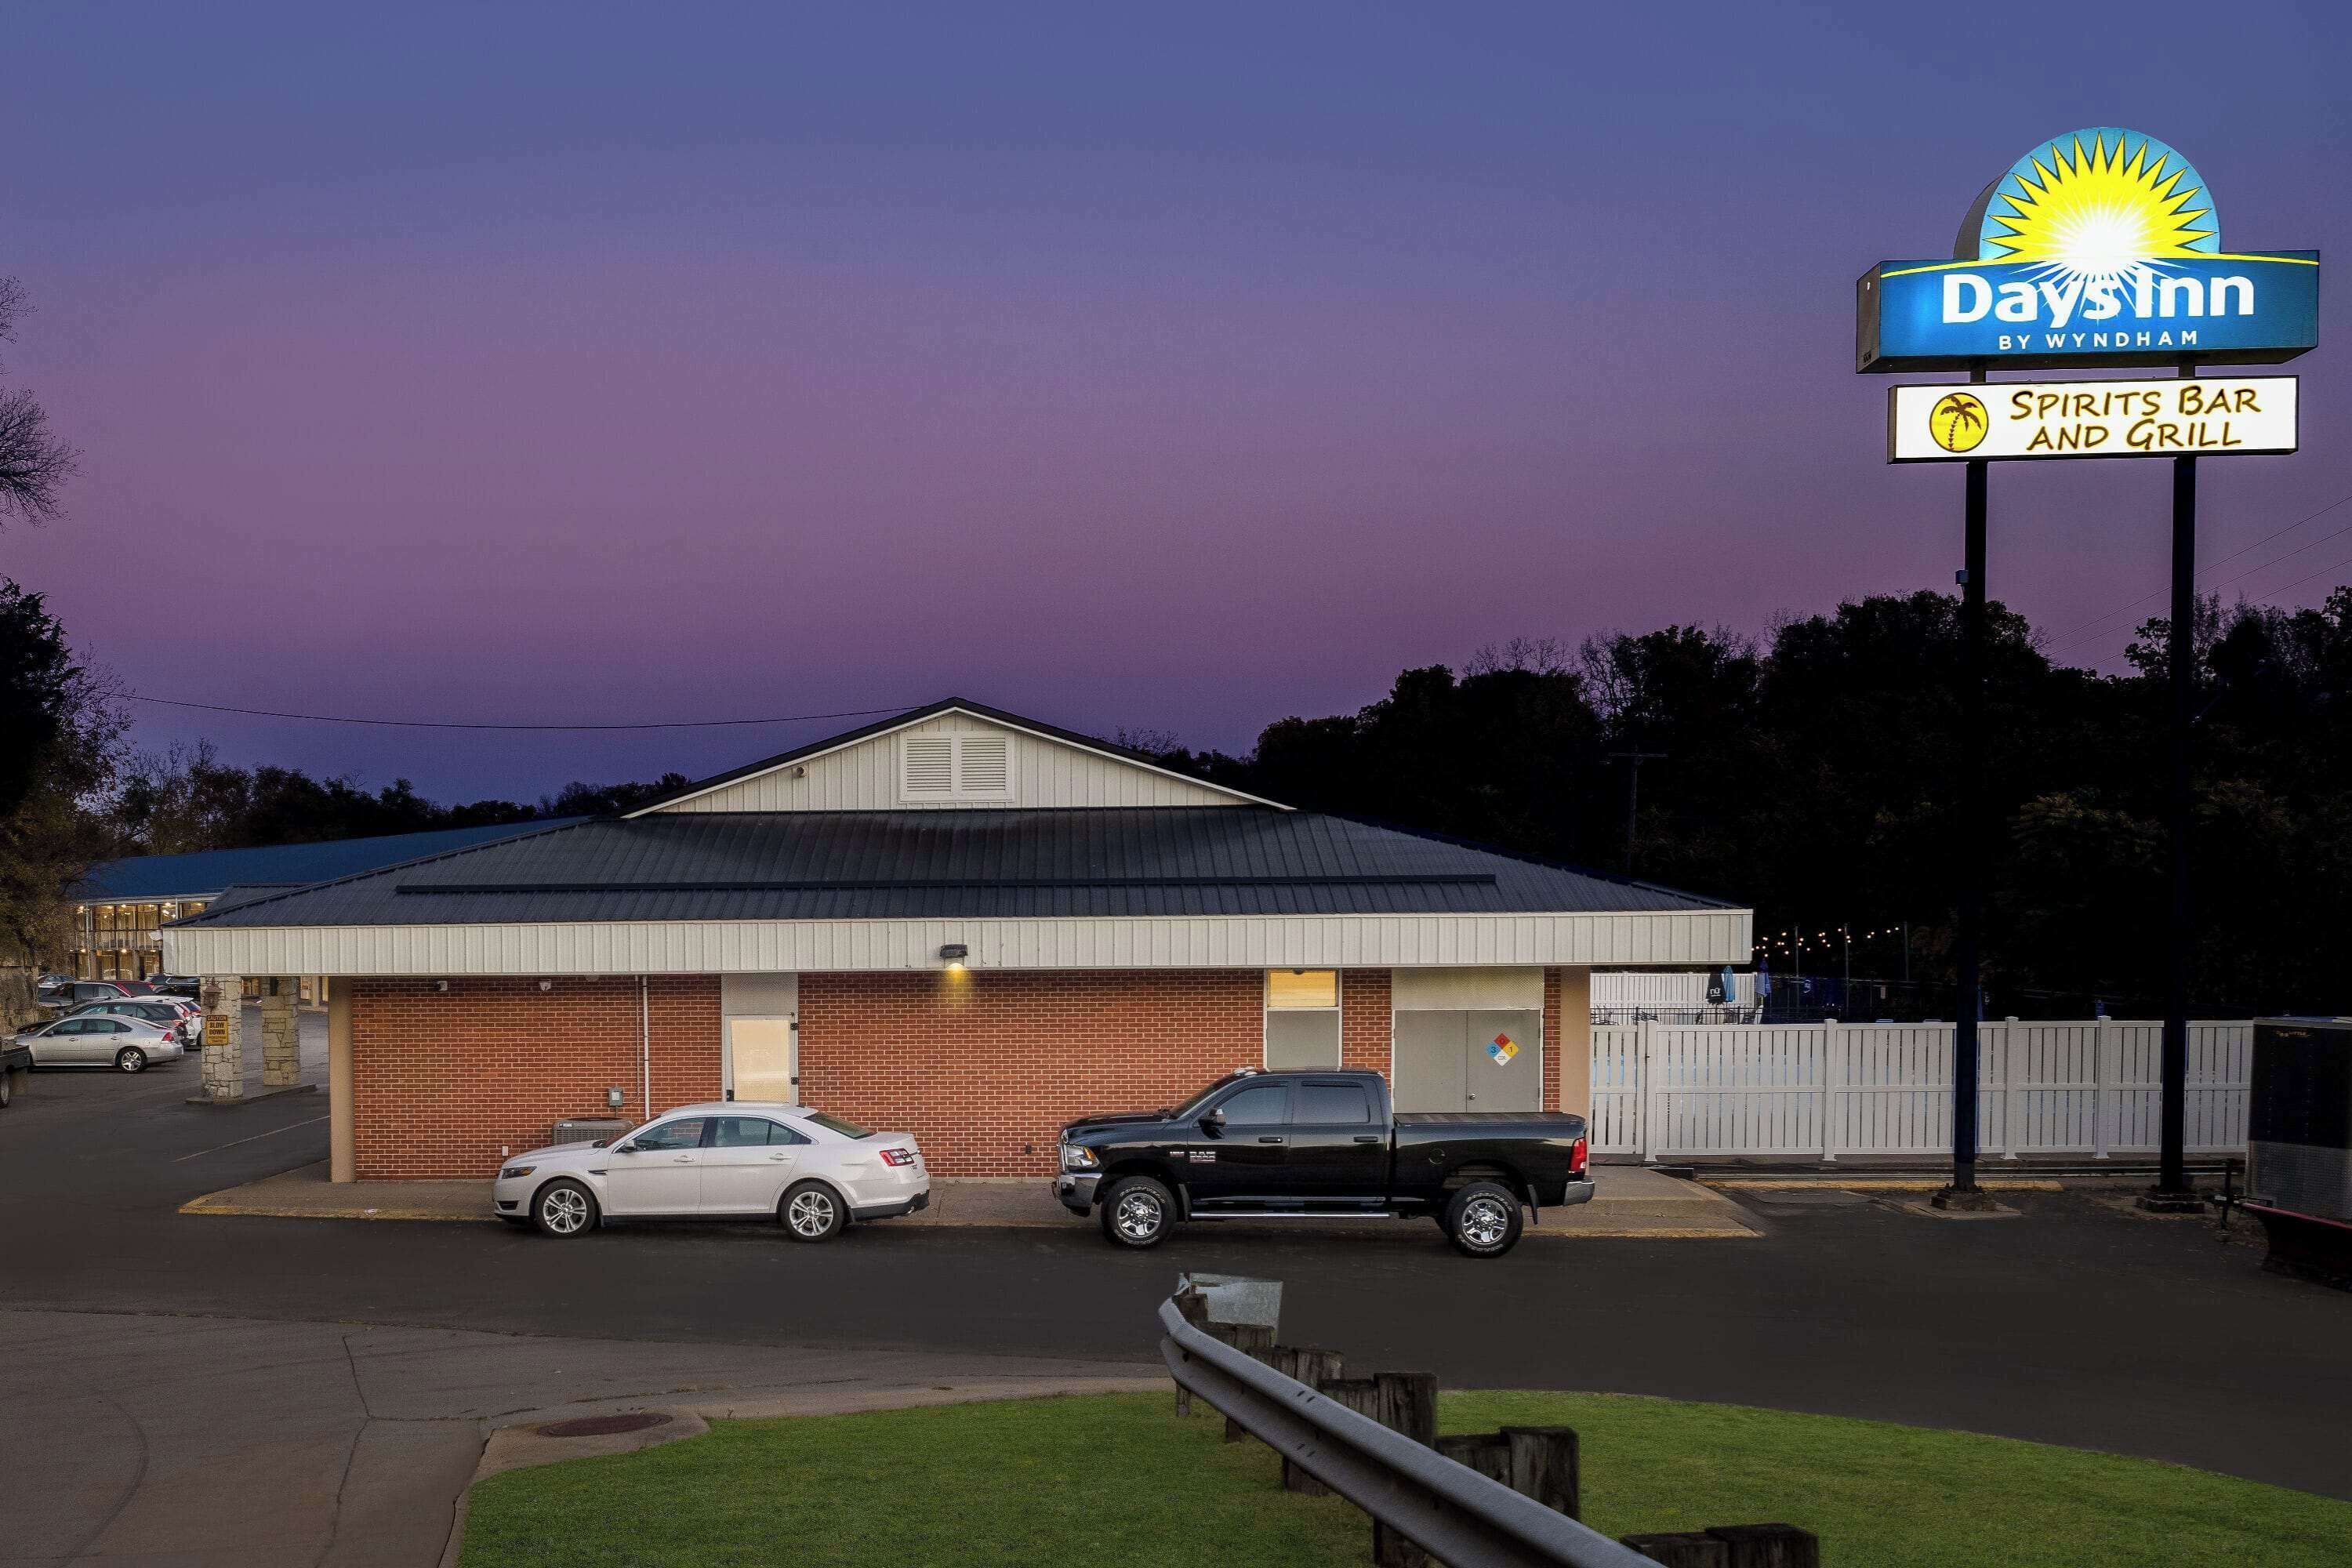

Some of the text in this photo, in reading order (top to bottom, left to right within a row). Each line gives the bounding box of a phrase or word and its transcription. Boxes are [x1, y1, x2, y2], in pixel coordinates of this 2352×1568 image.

[1942, 269, 2255, 328] Days Inn
[1998, 330, 2198, 350] BY WYNDHAM
[2010, 386, 2262, 420] SPIRITS BAR
[2026, 419, 2241, 452] AND GRILL
